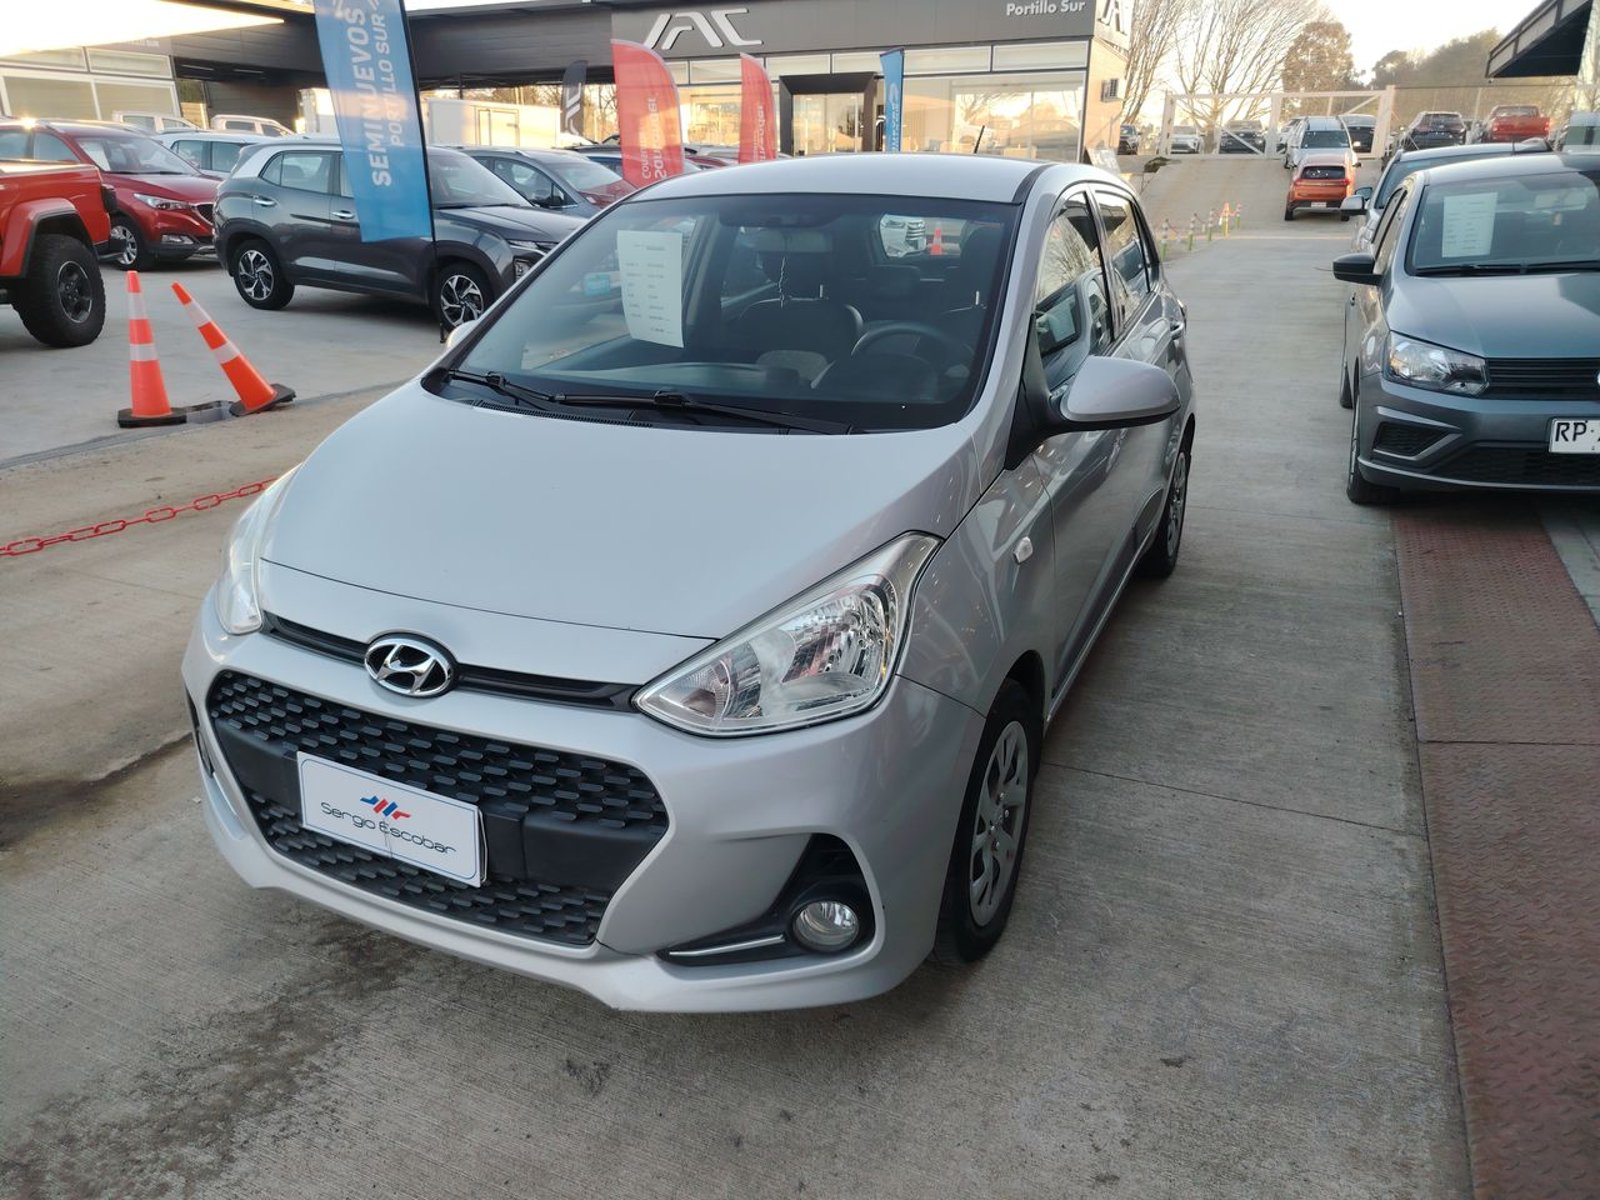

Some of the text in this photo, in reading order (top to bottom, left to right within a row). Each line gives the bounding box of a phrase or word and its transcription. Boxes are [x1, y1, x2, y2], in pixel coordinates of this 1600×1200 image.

[643, 8, 763, 50] JAC
[1006, 0, 1086, 16] Portillo Sur
[346, 7, 393, 187] SEMINUEVOS
[371, 14, 404, 147] PORTILLO SUR
[378, 820, 457, 854] Escobar
